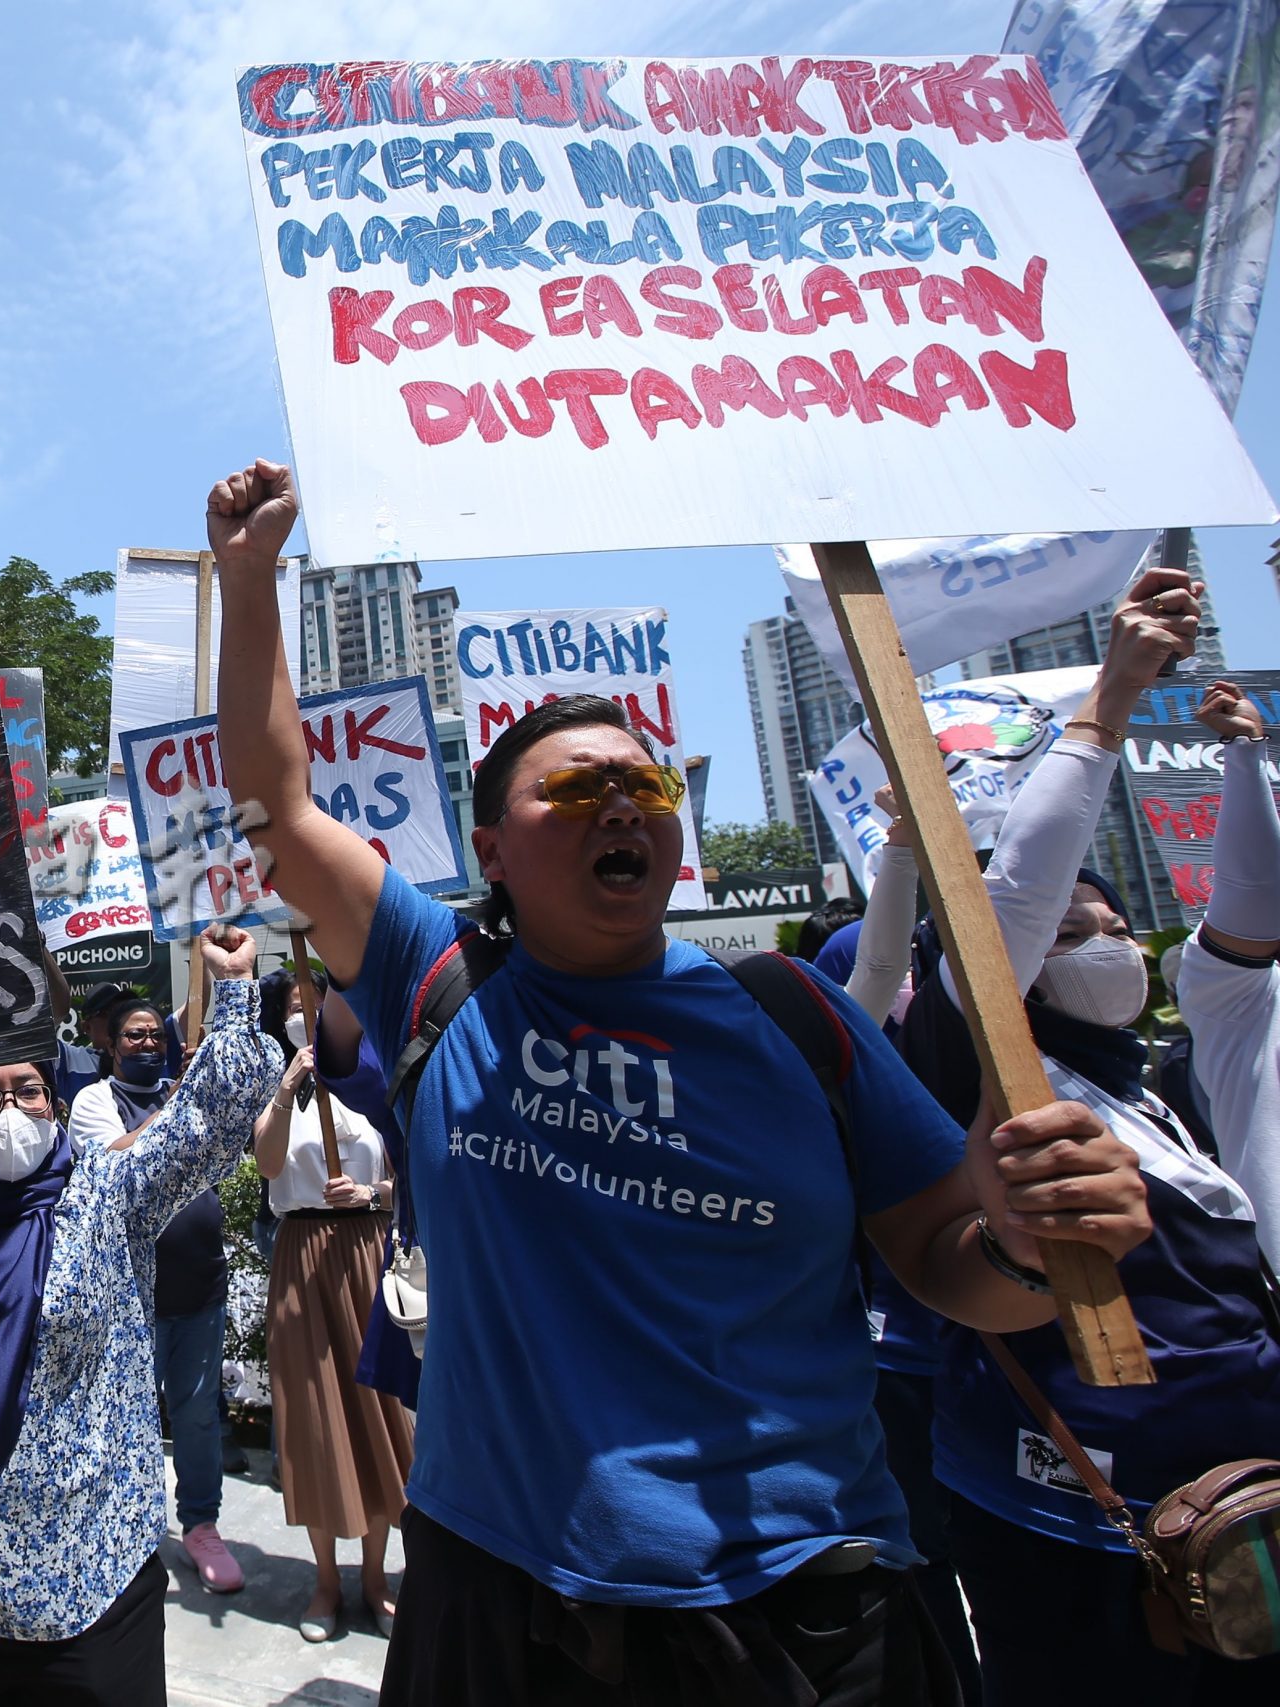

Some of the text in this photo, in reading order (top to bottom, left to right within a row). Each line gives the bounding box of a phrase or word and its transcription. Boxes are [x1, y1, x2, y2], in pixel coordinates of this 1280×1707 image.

[261, 132, 545, 207] PEKERJA
[698, 202, 999, 265] PEKERJA
[457, 618, 671, 680] CITIBANK
[707, 884, 812, 911] LAWATI
[56, 945, 144, 966] PUCHONG
[521, 1028, 675, 1118] citi
[511, 1087, 689, 1153] Malaysia
[449, 1126, 776, 1227] #CitiVolunteers
